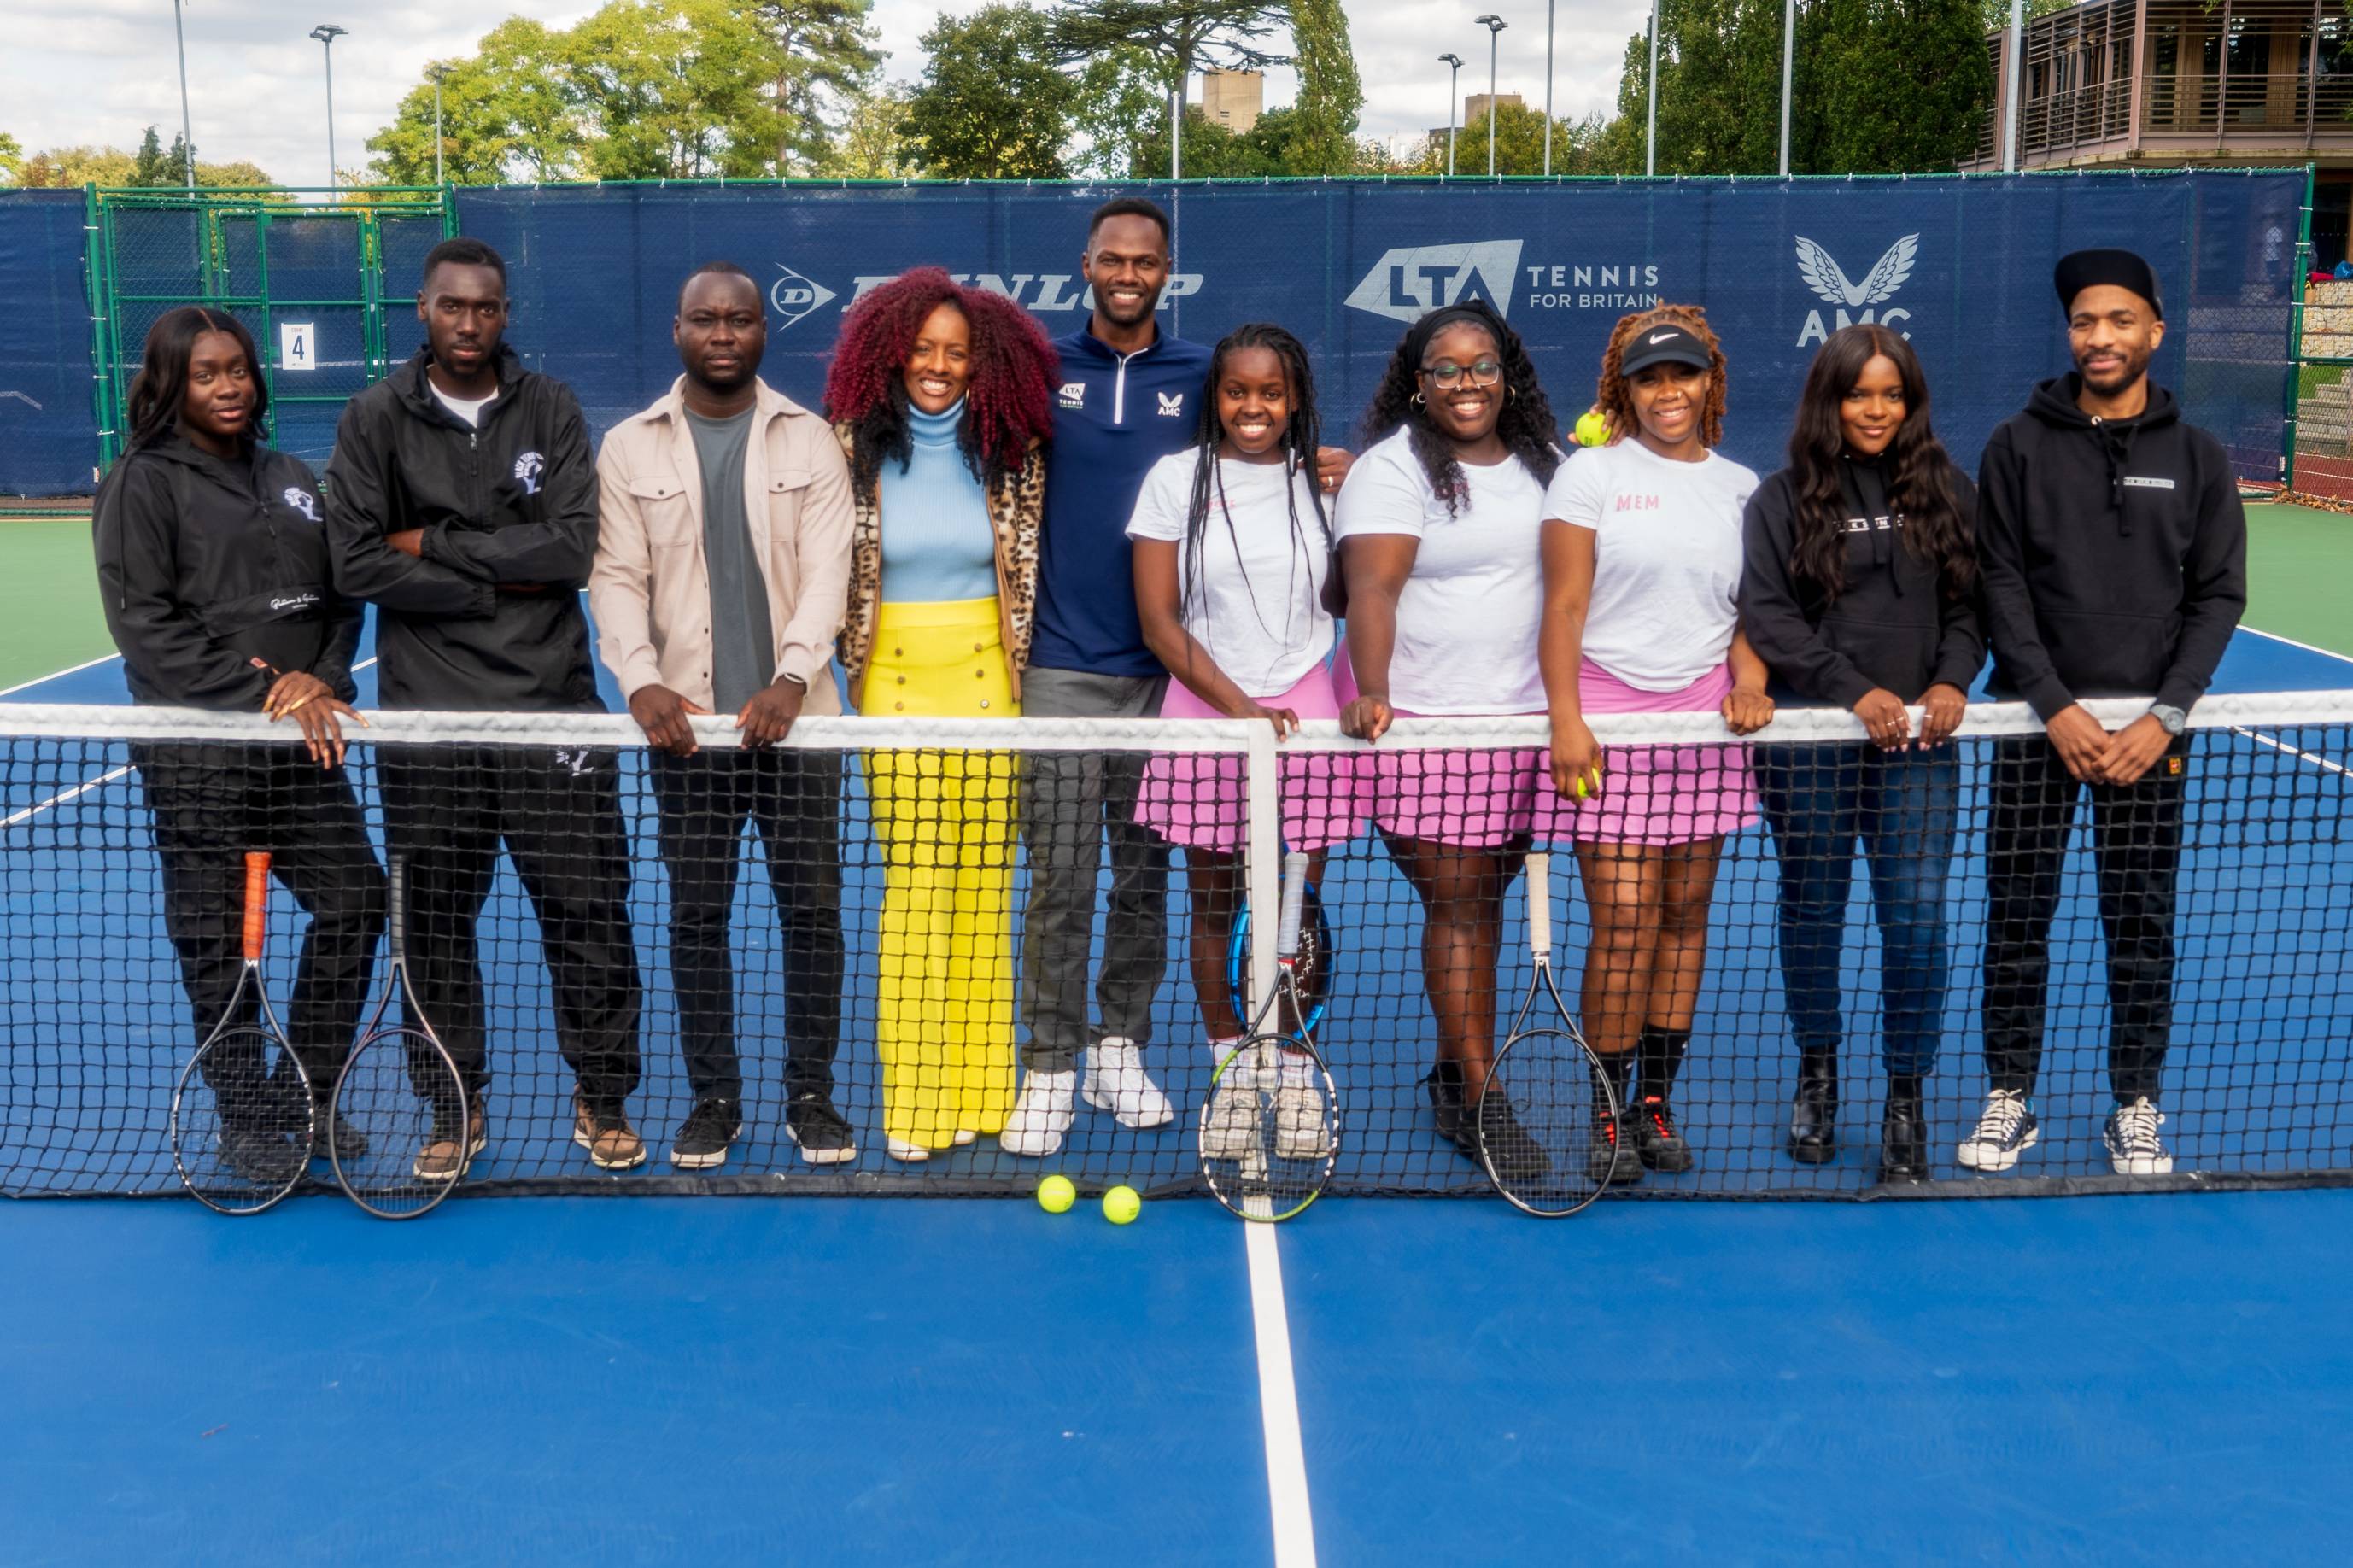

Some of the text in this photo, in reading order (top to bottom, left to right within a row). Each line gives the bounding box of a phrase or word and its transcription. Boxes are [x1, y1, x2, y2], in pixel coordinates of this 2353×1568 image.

[1527, 266, 1659, 287] TENNIS
[1390, 266, 1507, 319] LTA
[1530, 294, 1657, 308] FOR BRITAIN
[292, 335, 305, 360] 4
[1065, 387, 1081, 397] LTA
[1157, 406, 1181, 418] AMC
[1616, 494, 1659, 512] MEM
